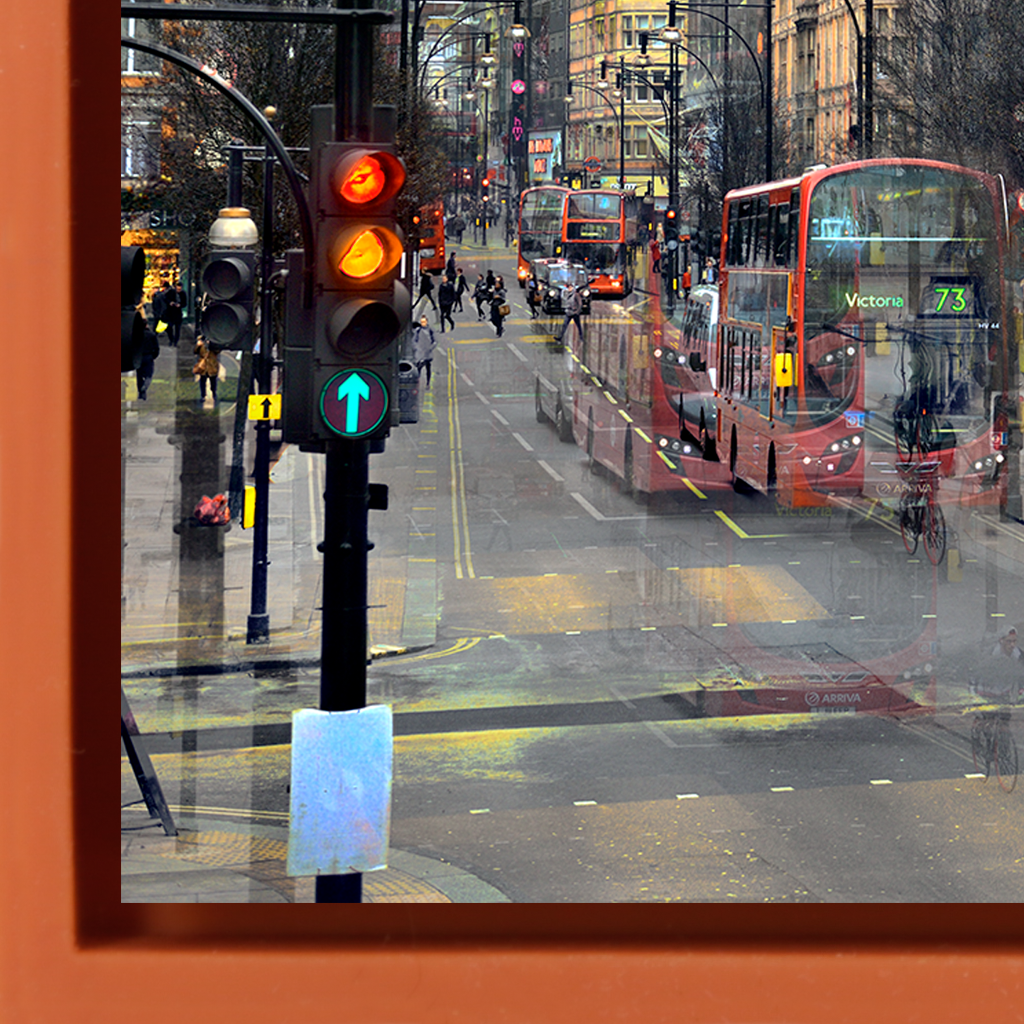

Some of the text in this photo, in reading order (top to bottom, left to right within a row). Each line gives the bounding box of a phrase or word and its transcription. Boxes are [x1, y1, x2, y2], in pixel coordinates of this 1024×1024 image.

[511, 117, 524, 142] hmv
[845, 288, 967, 312] Victoria 73
[775, 503, 833, 517] Victoria
[822, 693, 861, 703] ARRIVA
